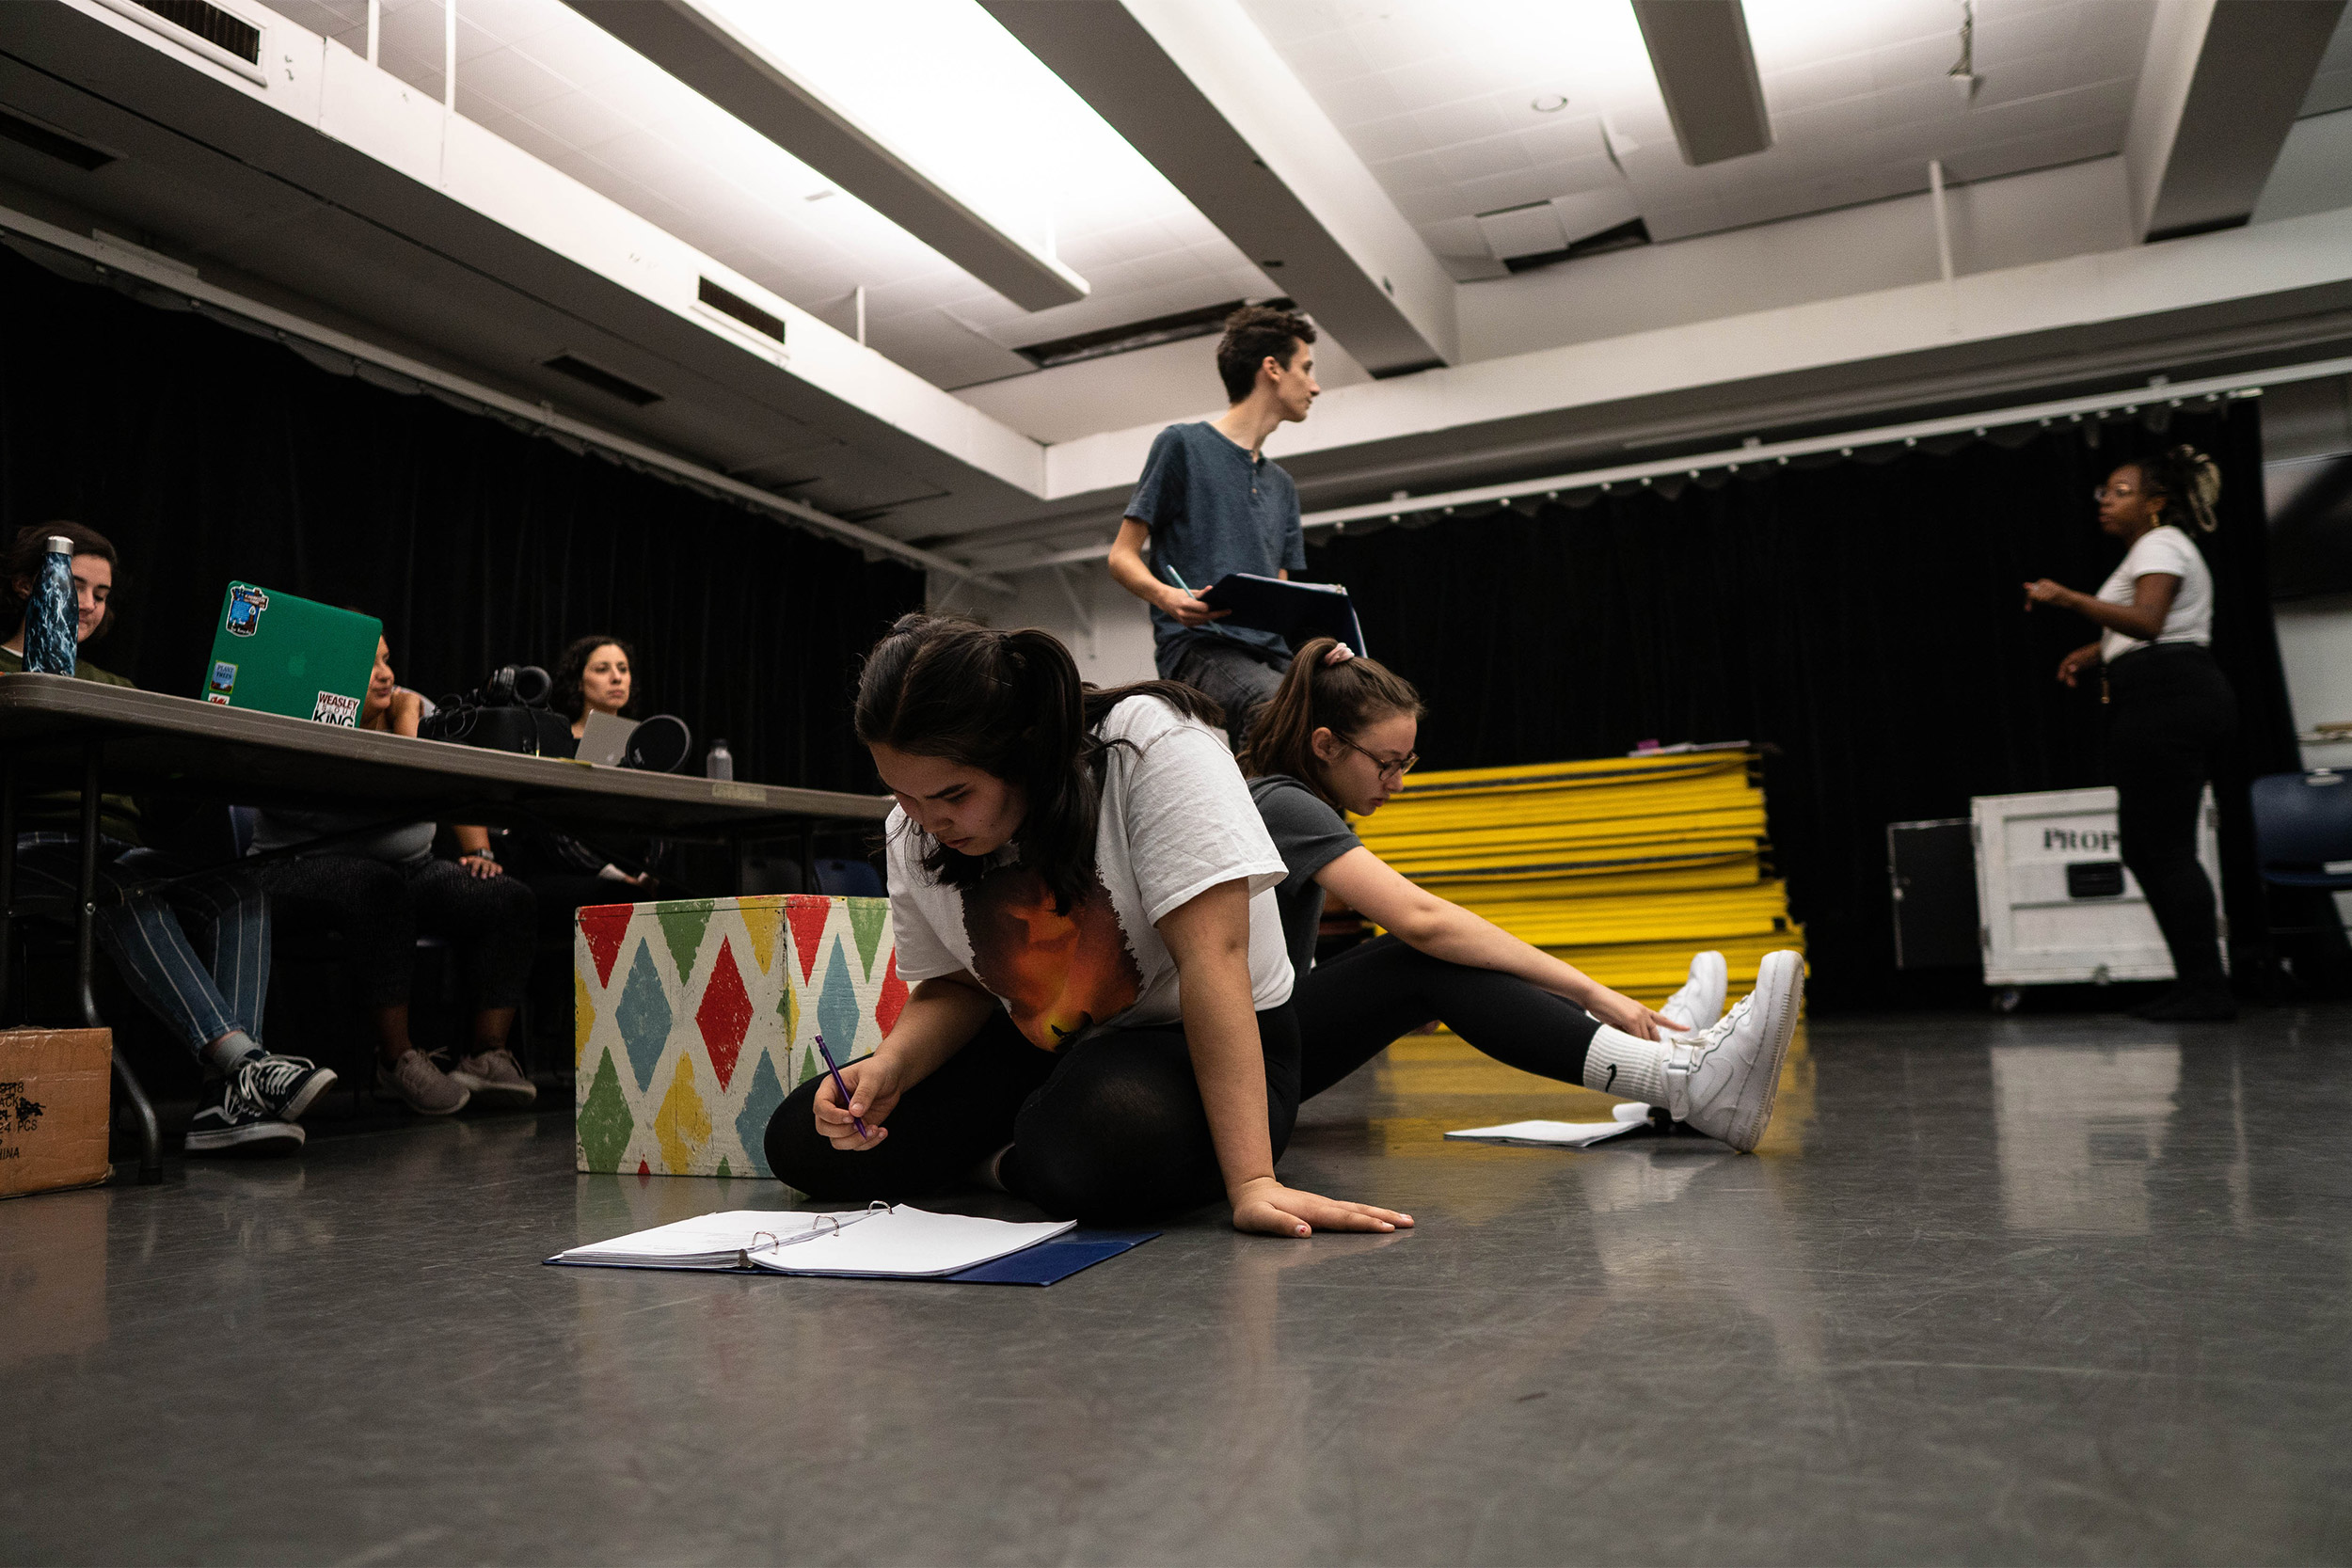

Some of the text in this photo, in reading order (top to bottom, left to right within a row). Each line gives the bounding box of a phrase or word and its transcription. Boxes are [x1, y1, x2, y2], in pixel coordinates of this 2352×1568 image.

[217, 664, 234, 673] PLANT
[319, 693, 358, 710] WEASLEY
[313, 710, 354, 727] KING
[334, 706, 356, 719] OUR
[2044, 829, 2120, 851] PROP
[18, 1119, 38, 1132] PCS
